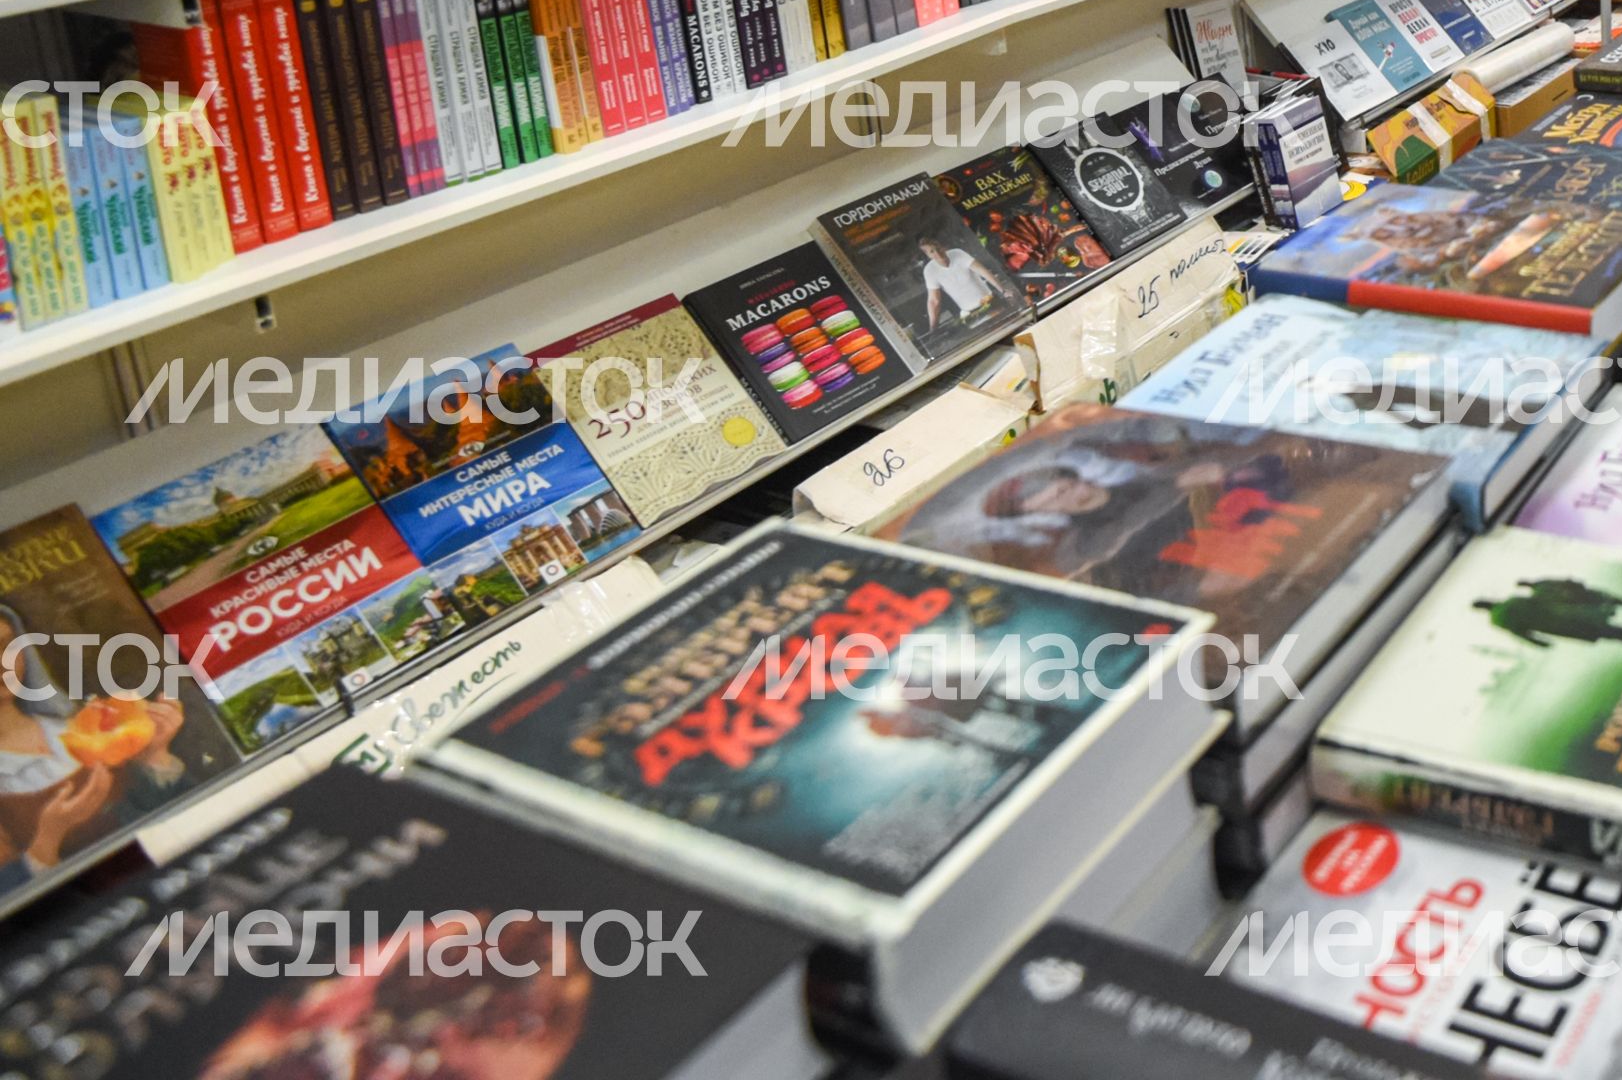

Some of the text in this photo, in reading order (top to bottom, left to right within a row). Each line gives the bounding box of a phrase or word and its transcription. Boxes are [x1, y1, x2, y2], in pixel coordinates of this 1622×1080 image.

[427, 34, 448, 109] СТРАШНАЯ ХИМИЯ
[449, 31, 469, 106] СТРАШНАЯ ХИМИЯ
[467, 25, 487, 100] СТРАШНАЯ ХИМИЯ
[687, 15, 708, 89] MACARONS
[833, 179, 930, 229] ГОРДОН РАМЗИ
[974, 169, 1011, 192] ВАХ
[724, 275, 832, 332] MACARONS
[587, 398, 646, 440] 250
[418, 443, 565, 519] ИНТЕРЕСНЫЕ МЕСТА
[456, 451, 512, 483] САМЫЕ
[456, 472, 553, 527] МИРА
[209, 538, 357, 618] КРАСИВЫЕ МЕСТА
[245, 544, 310, 585] САМЫЕ
[209, 546, 384, 652] РОССИИ
